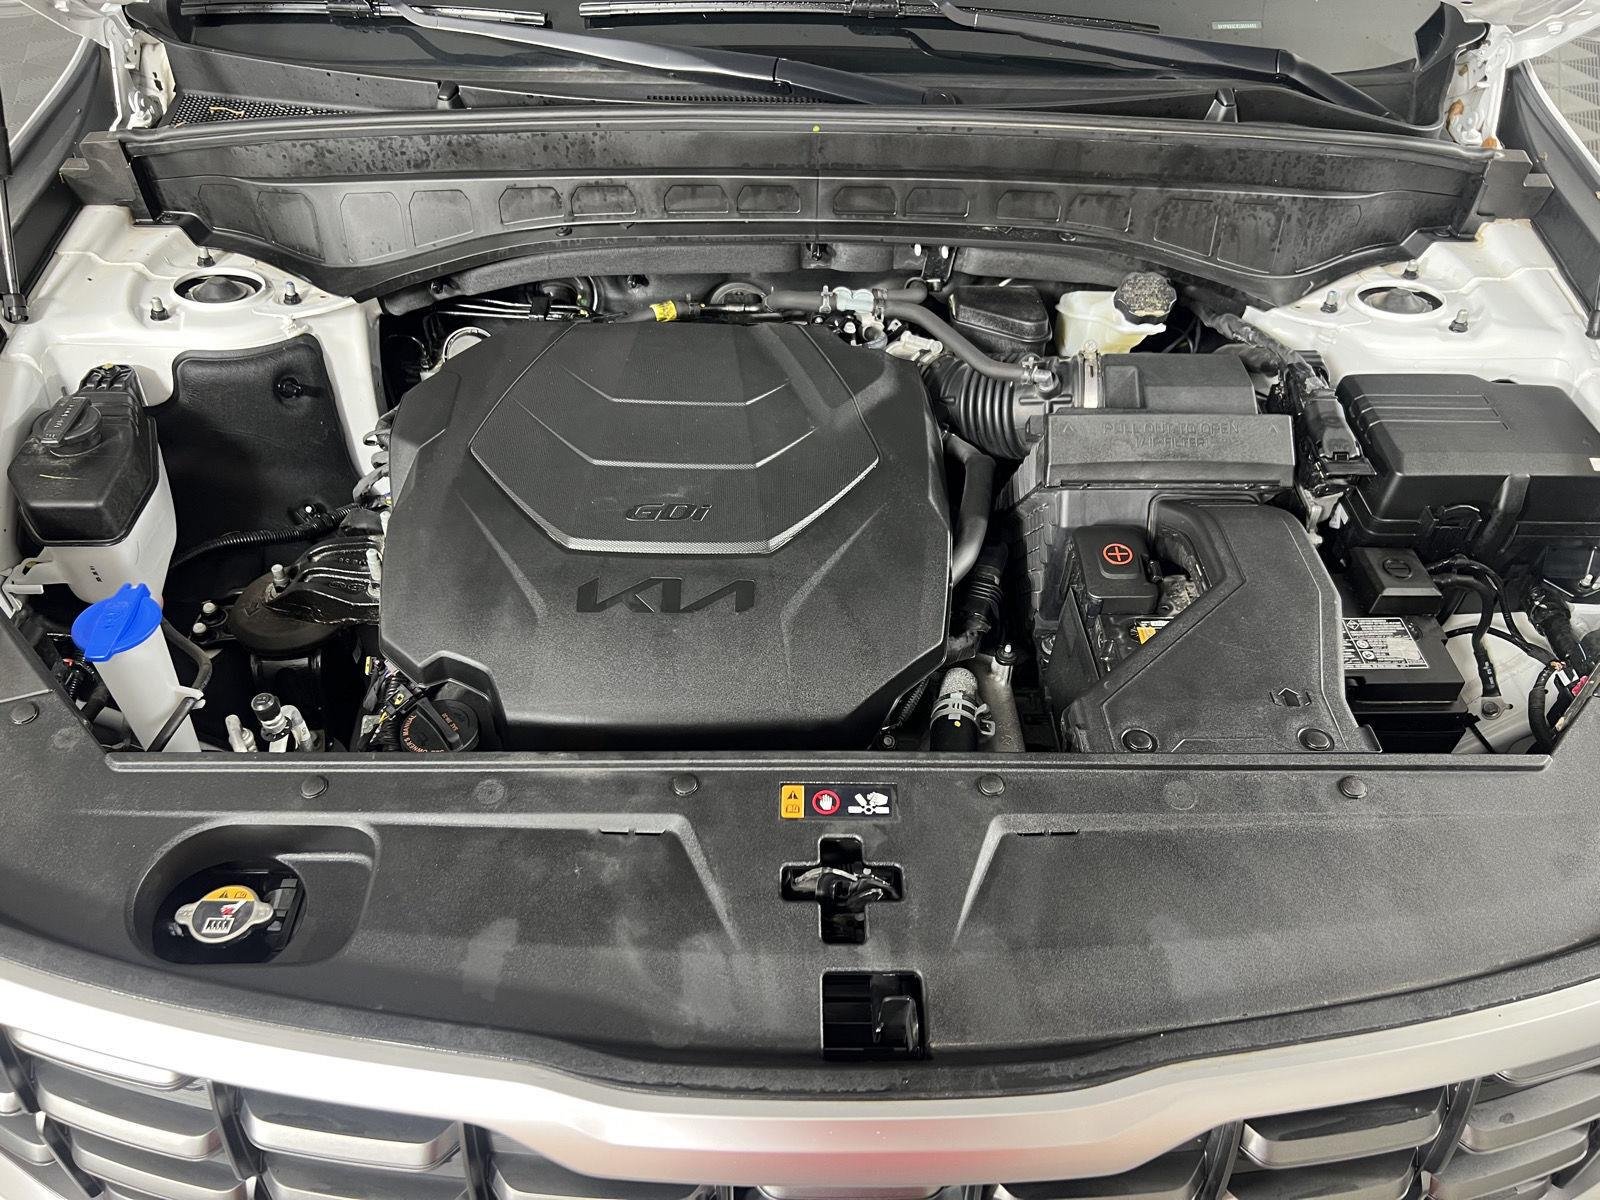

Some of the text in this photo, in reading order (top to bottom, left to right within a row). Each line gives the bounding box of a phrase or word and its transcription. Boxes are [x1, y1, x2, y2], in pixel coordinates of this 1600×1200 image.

[1201, 421, 1240, 435] OPEN
[625, 502, 713, 522] GDi
[576, 576, 756, 614] KIA
